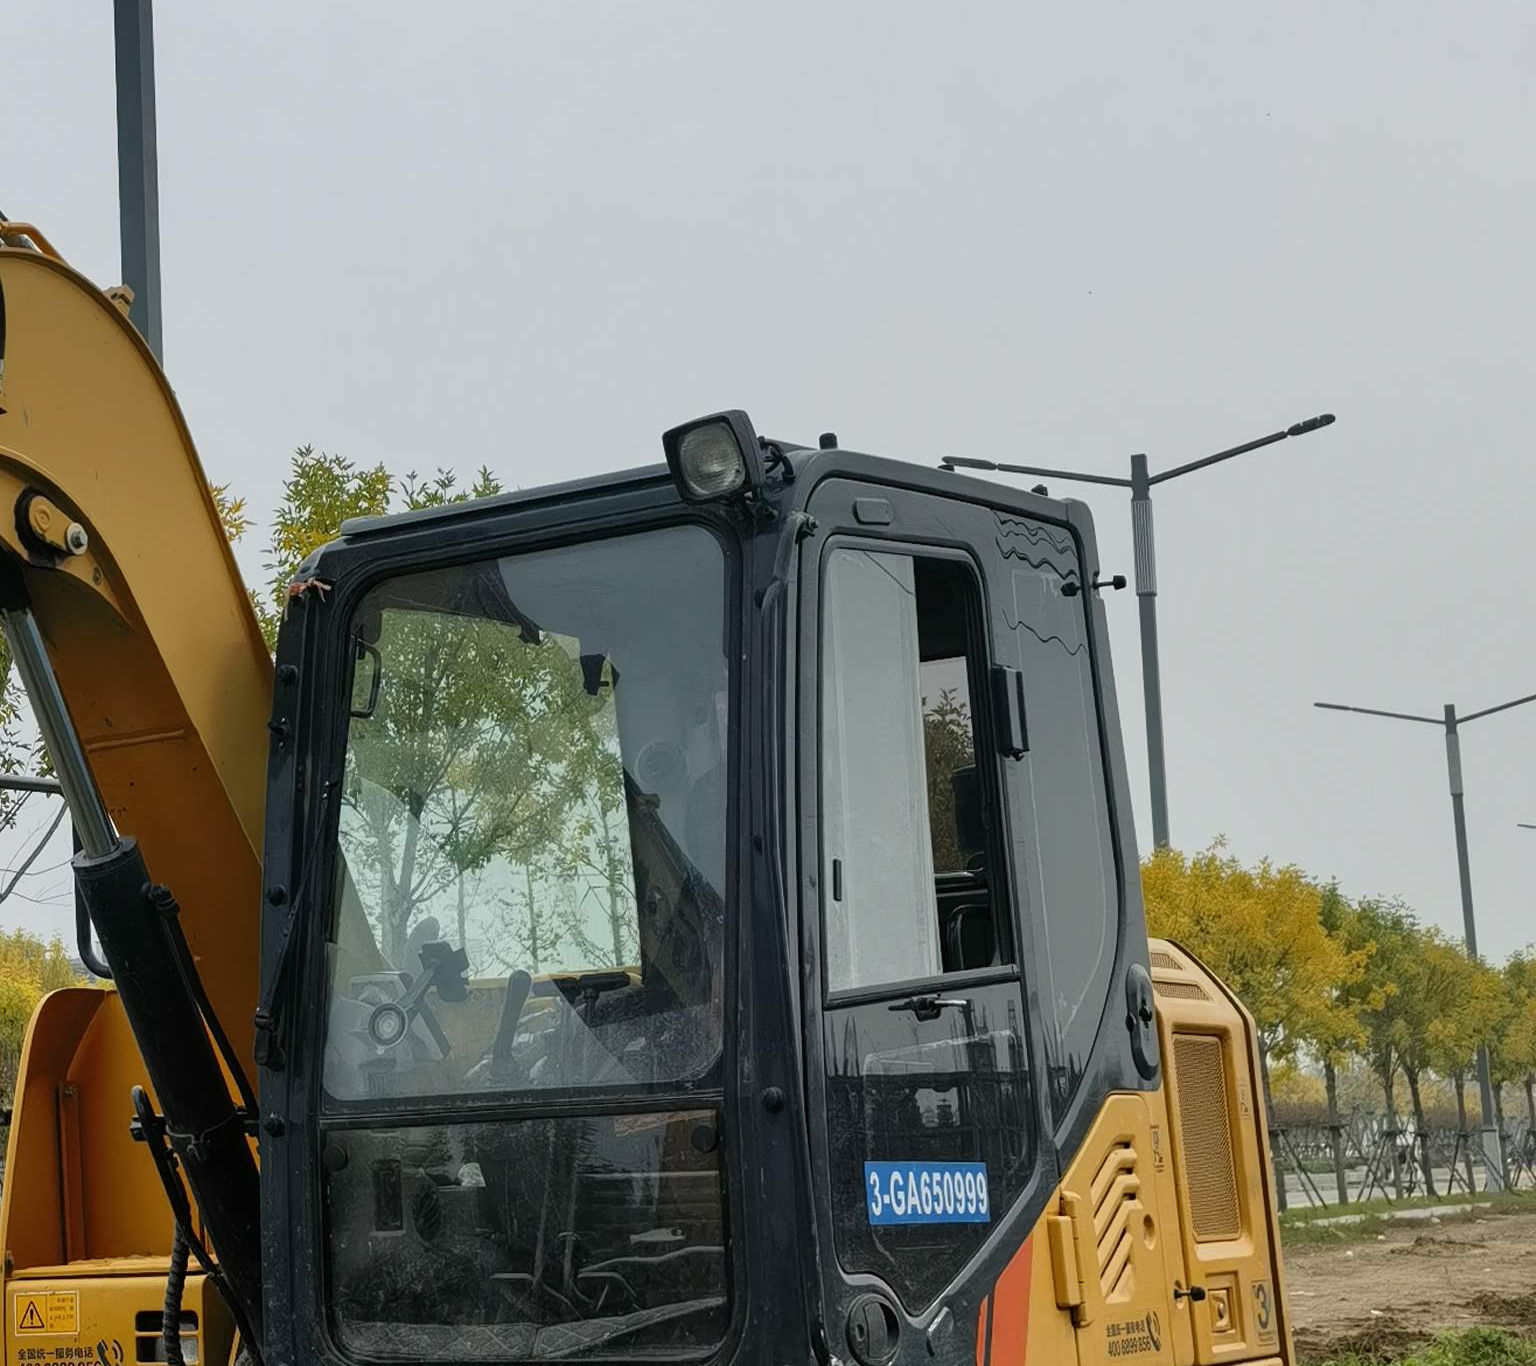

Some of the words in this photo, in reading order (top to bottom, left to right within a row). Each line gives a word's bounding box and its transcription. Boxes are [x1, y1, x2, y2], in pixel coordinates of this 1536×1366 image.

[869, 1170, 988, 1216] 3-GA650999
[17, 1346, 94, 1361] 全国统一服务电话
